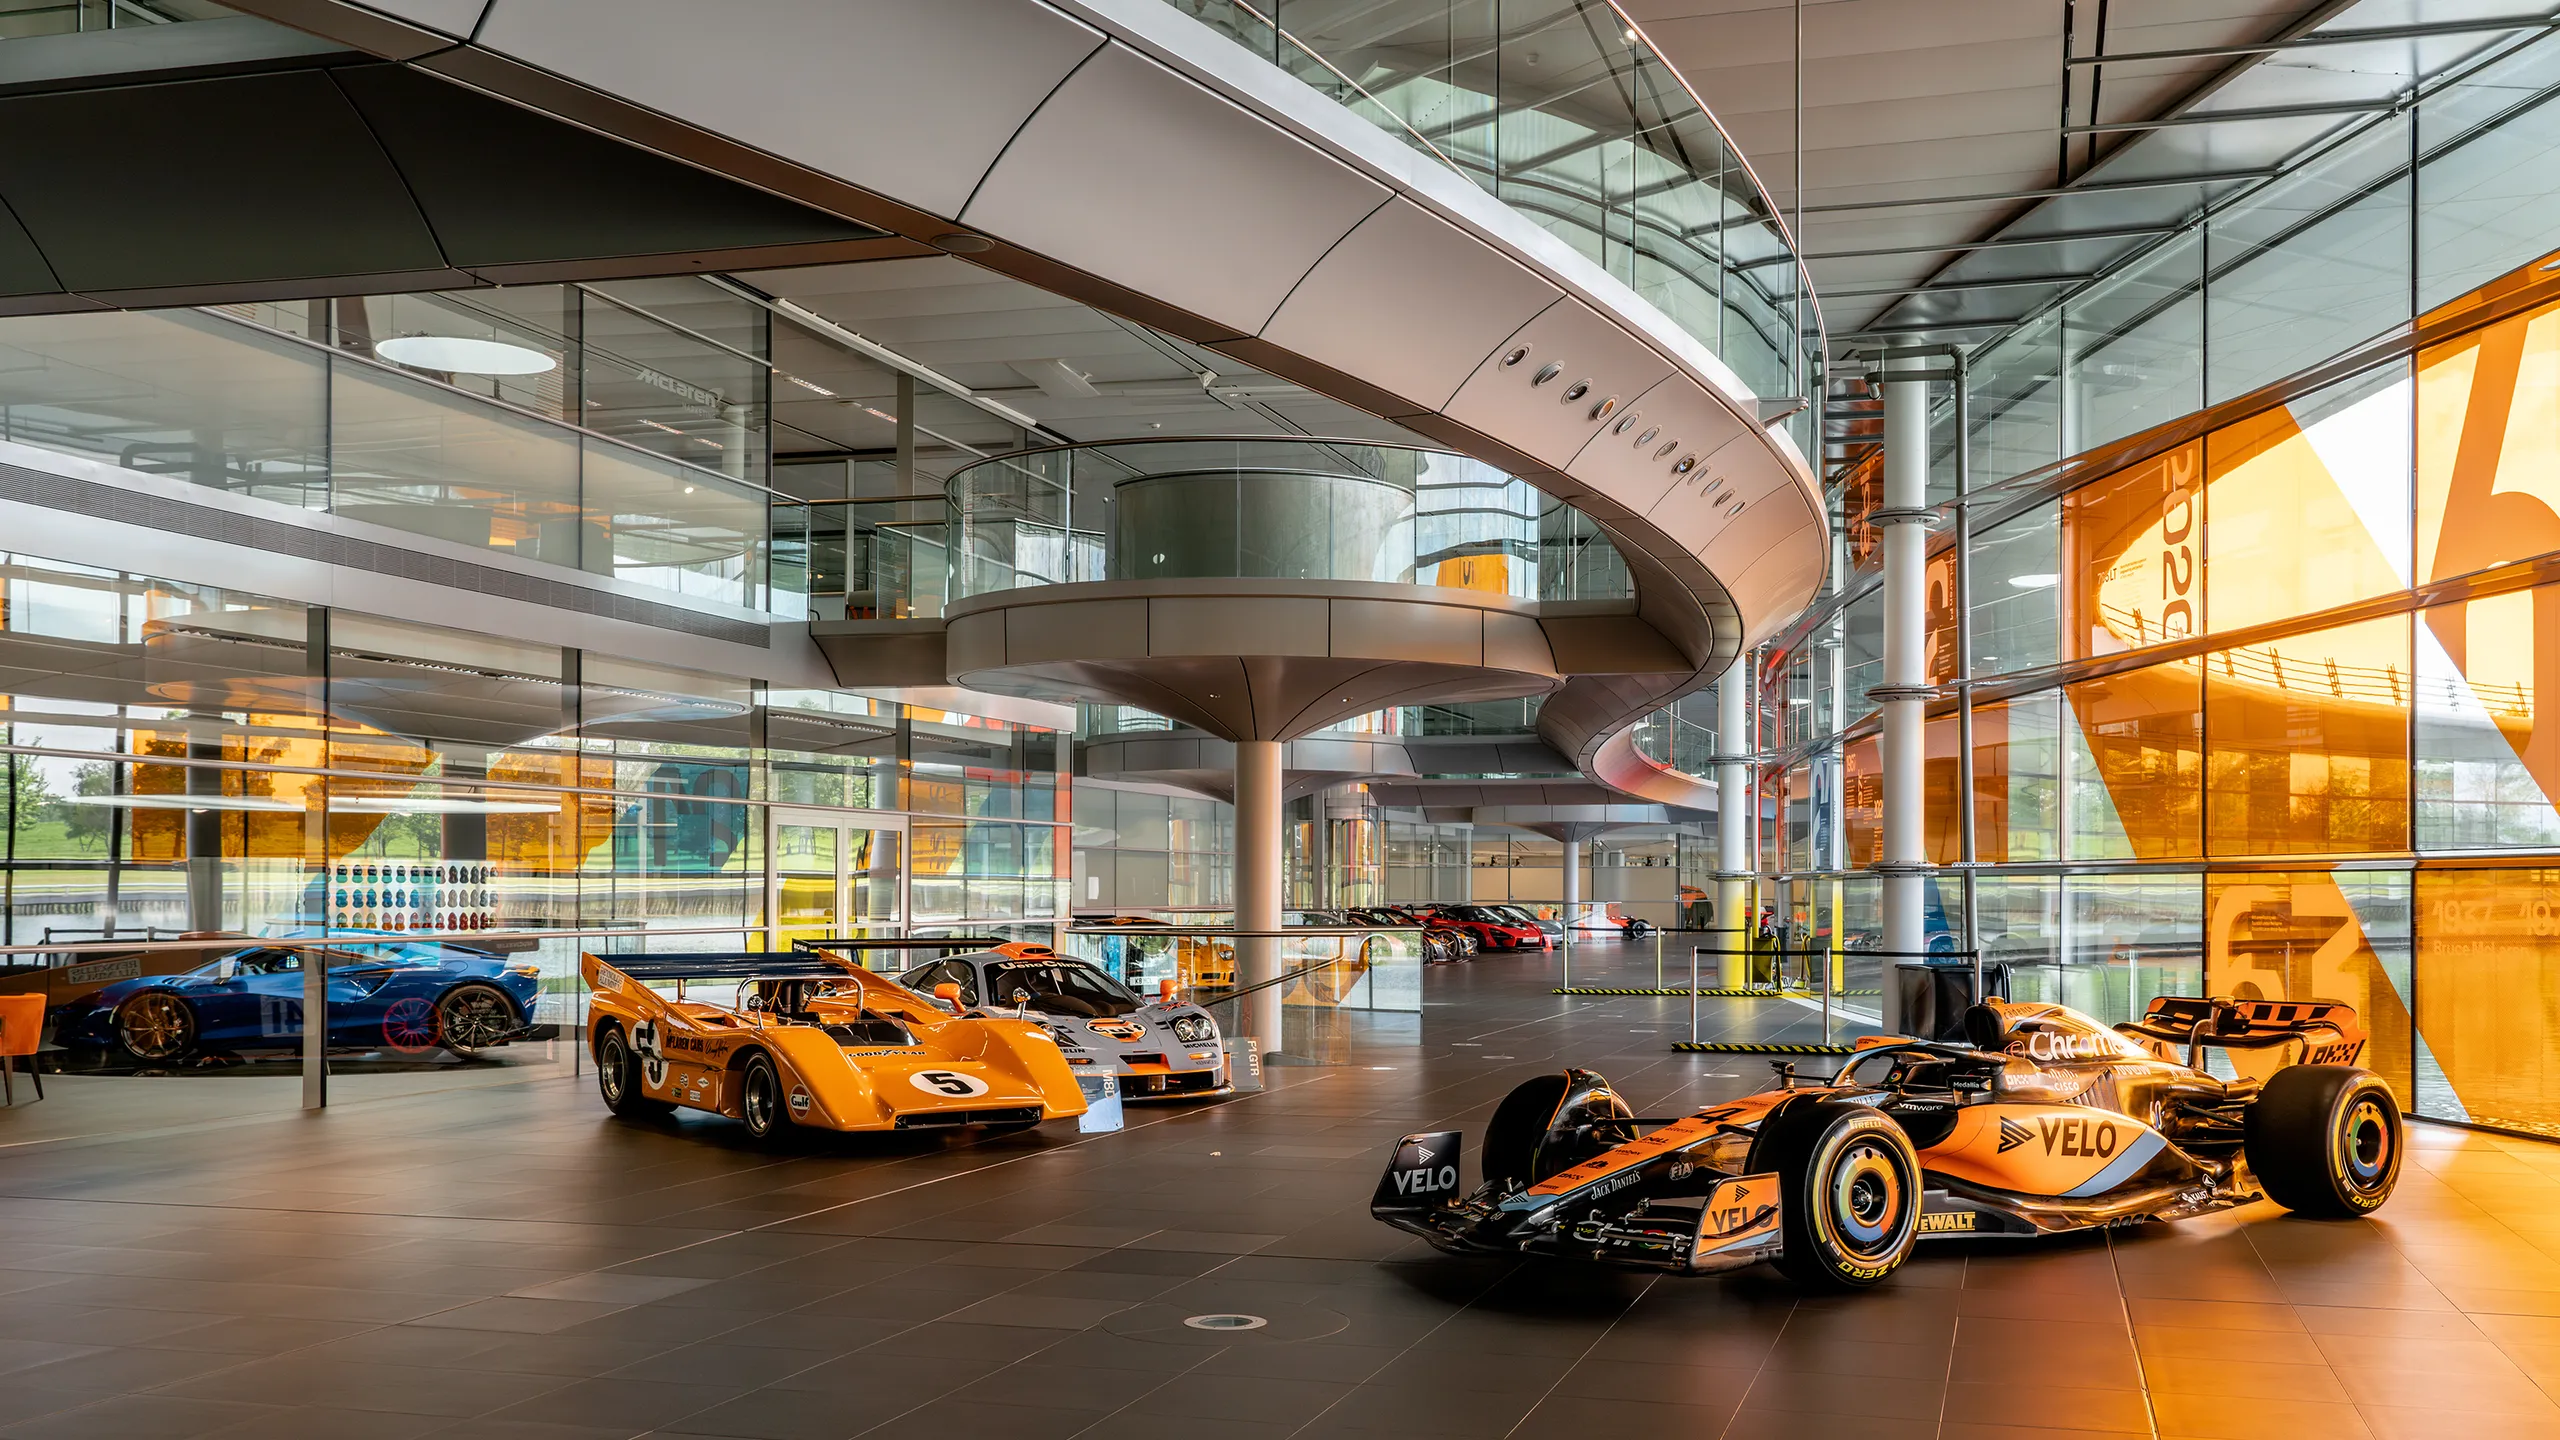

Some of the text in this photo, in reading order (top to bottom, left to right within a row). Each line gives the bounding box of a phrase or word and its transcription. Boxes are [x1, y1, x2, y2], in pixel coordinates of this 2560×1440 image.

[636, 368, 717, 408] McLaren
[2433, 940, 2470, 955] Bruce
[1247, 1040, 1260, 1077] F1 GTR
[921, 1072, 974, 1095] 5
[1102, 1069, 1115, 1099] M8D
[2054, 1082, 2080, 1091] CISCO
[790, 1095, 809, 1108] Gulf
[1899, 1103, 1944, 1111] vmware
[1690, 1107, 1748, 1124] 4
[1848, 1117, 1882, 1129] PIRELLI
[2037, 1117, 2117, 1158] VELO
[1670, 1163, 1692, 1178] FIA
[1393, 1165, 1457, 1195] VELO
[1591, 1183, 1611, 1200] JACK
[2352, 1193, 2386, 1209] ZERO
[1921, 1213, 1975, 1230] EWALT
[1838, 1252, 1902, 1279] P ZERO
